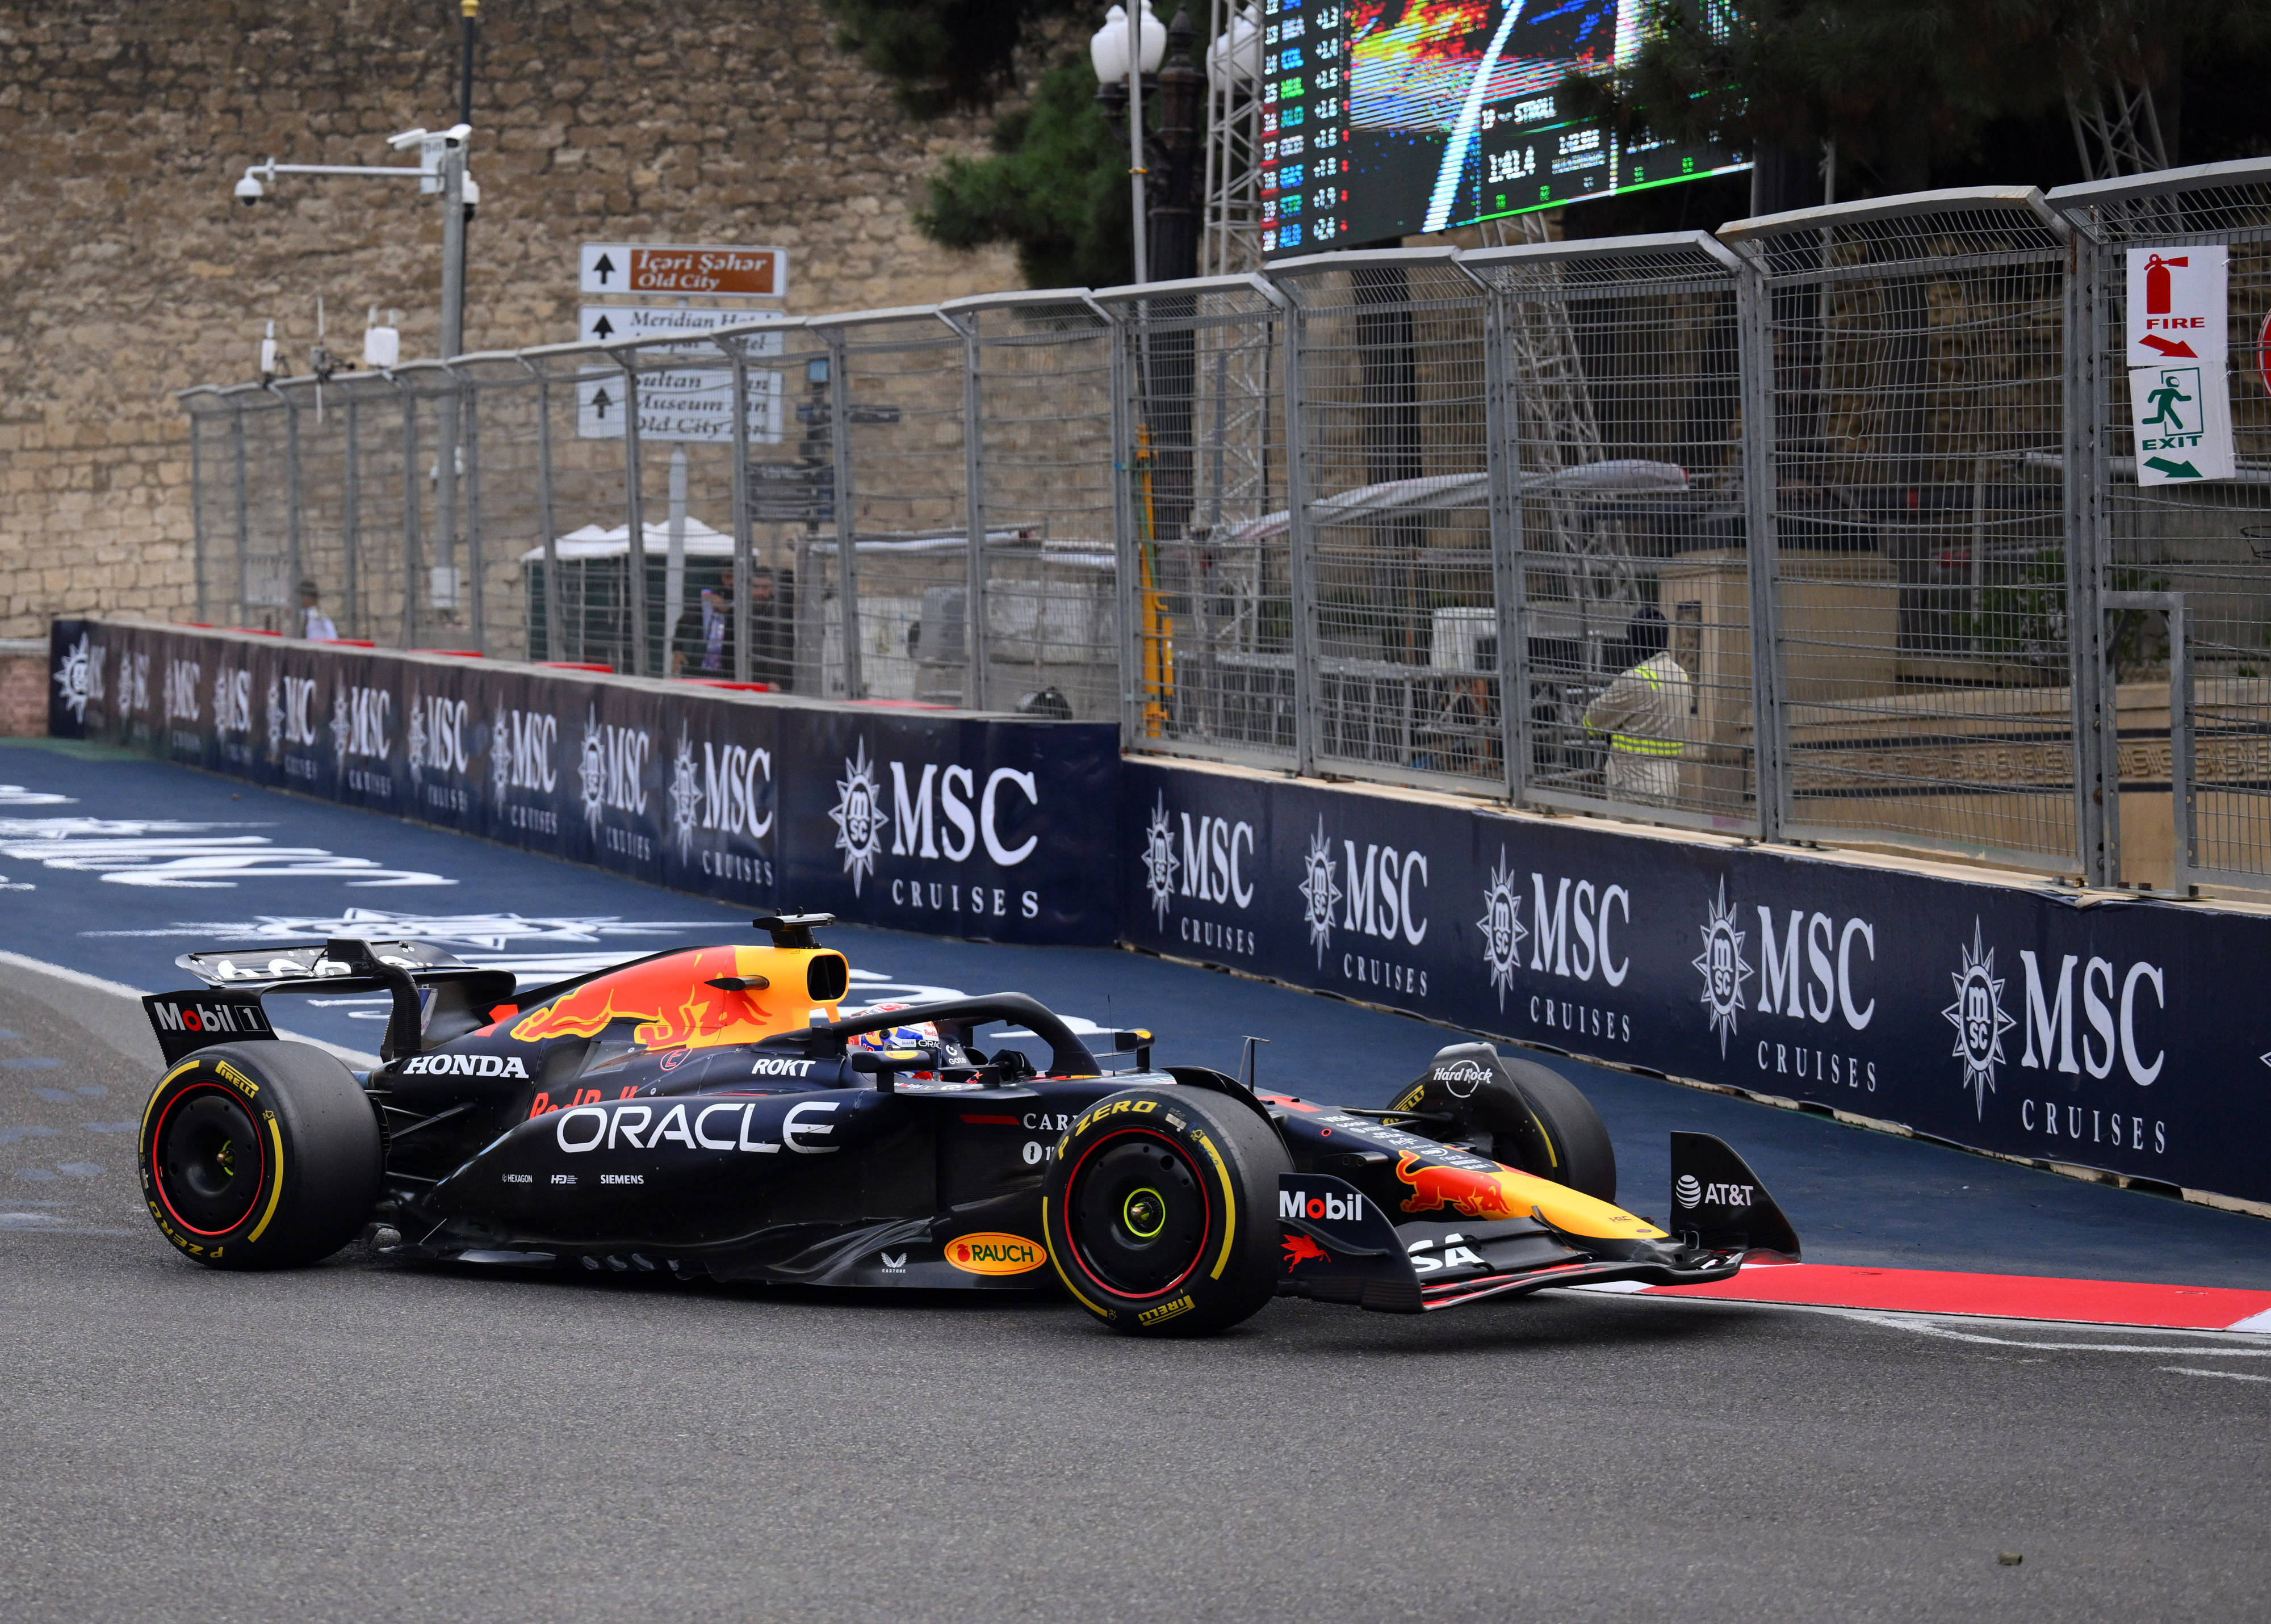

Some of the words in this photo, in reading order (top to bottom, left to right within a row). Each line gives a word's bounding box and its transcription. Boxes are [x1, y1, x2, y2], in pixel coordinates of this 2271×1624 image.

[638, 273, 677, 288] Old
[680, 274, 720, 291] City
[630, 312, 714, 328] Meridian
[2147, 317, 2205, 330] FIRE
[2142, 435, 2203, 451] EXIT
[427, 695, 469, 774] MSC
[512, 710, 557, 794] MSC
[606, 724, 650, 816] MSC
[702, 741, 773, 839] MSC
[890, 761, 1039, 867] MSC
[702, 849, 774, 887] CRUISES
[1180, 812, 1254, 909] MSC
[892, 878, 1040, 920] CRUISES
[1343, 839, 1428, 946] MSC
[1181, 917, 1255, 956] CRUISES
[1531, 872, 1629, 987] MSC
[1343, 952, 1428, 997] CRUISES
[1757, 905, 1875, 1031] MSC
[154, 1002, 237, 1032] Mobil
[1530, 996, 1631, 1043] CRUISES
[2019, 949, 2165, 1086] MSC
[215, 1060, 259, 1099] PIRELLI
[403, 1054, 529, 1080] HONDA
[752, 1059, 816, 1077] ROKT
[948, 1056, 967, 1065] Gate
[1433, 1067, 1464, 1081] Hard
[1463, 1067, 1493, 1084] Rock
[1758, 1040, 1876, 1093] CRUISES
[556, 1101, 841, 1154] ORACLE
[1023, 1113, 1079, 1131] CAR
[1075, 1100, 1159, 1137] ZERO
[2022, 1098, 2166, 1155] CRUISES
[508, 1174, 533, 1183] HEXAGON
[600, 1174, 644, 1185] SIEMENS
[1704, 1183, 1754, 1206] AT&T
[1279, 1190, 1362, 1221] Mobil
[971, 1244, 1034, 1263] RAUCH
[1138, 1295, 1196, 1327] PIRELLI
